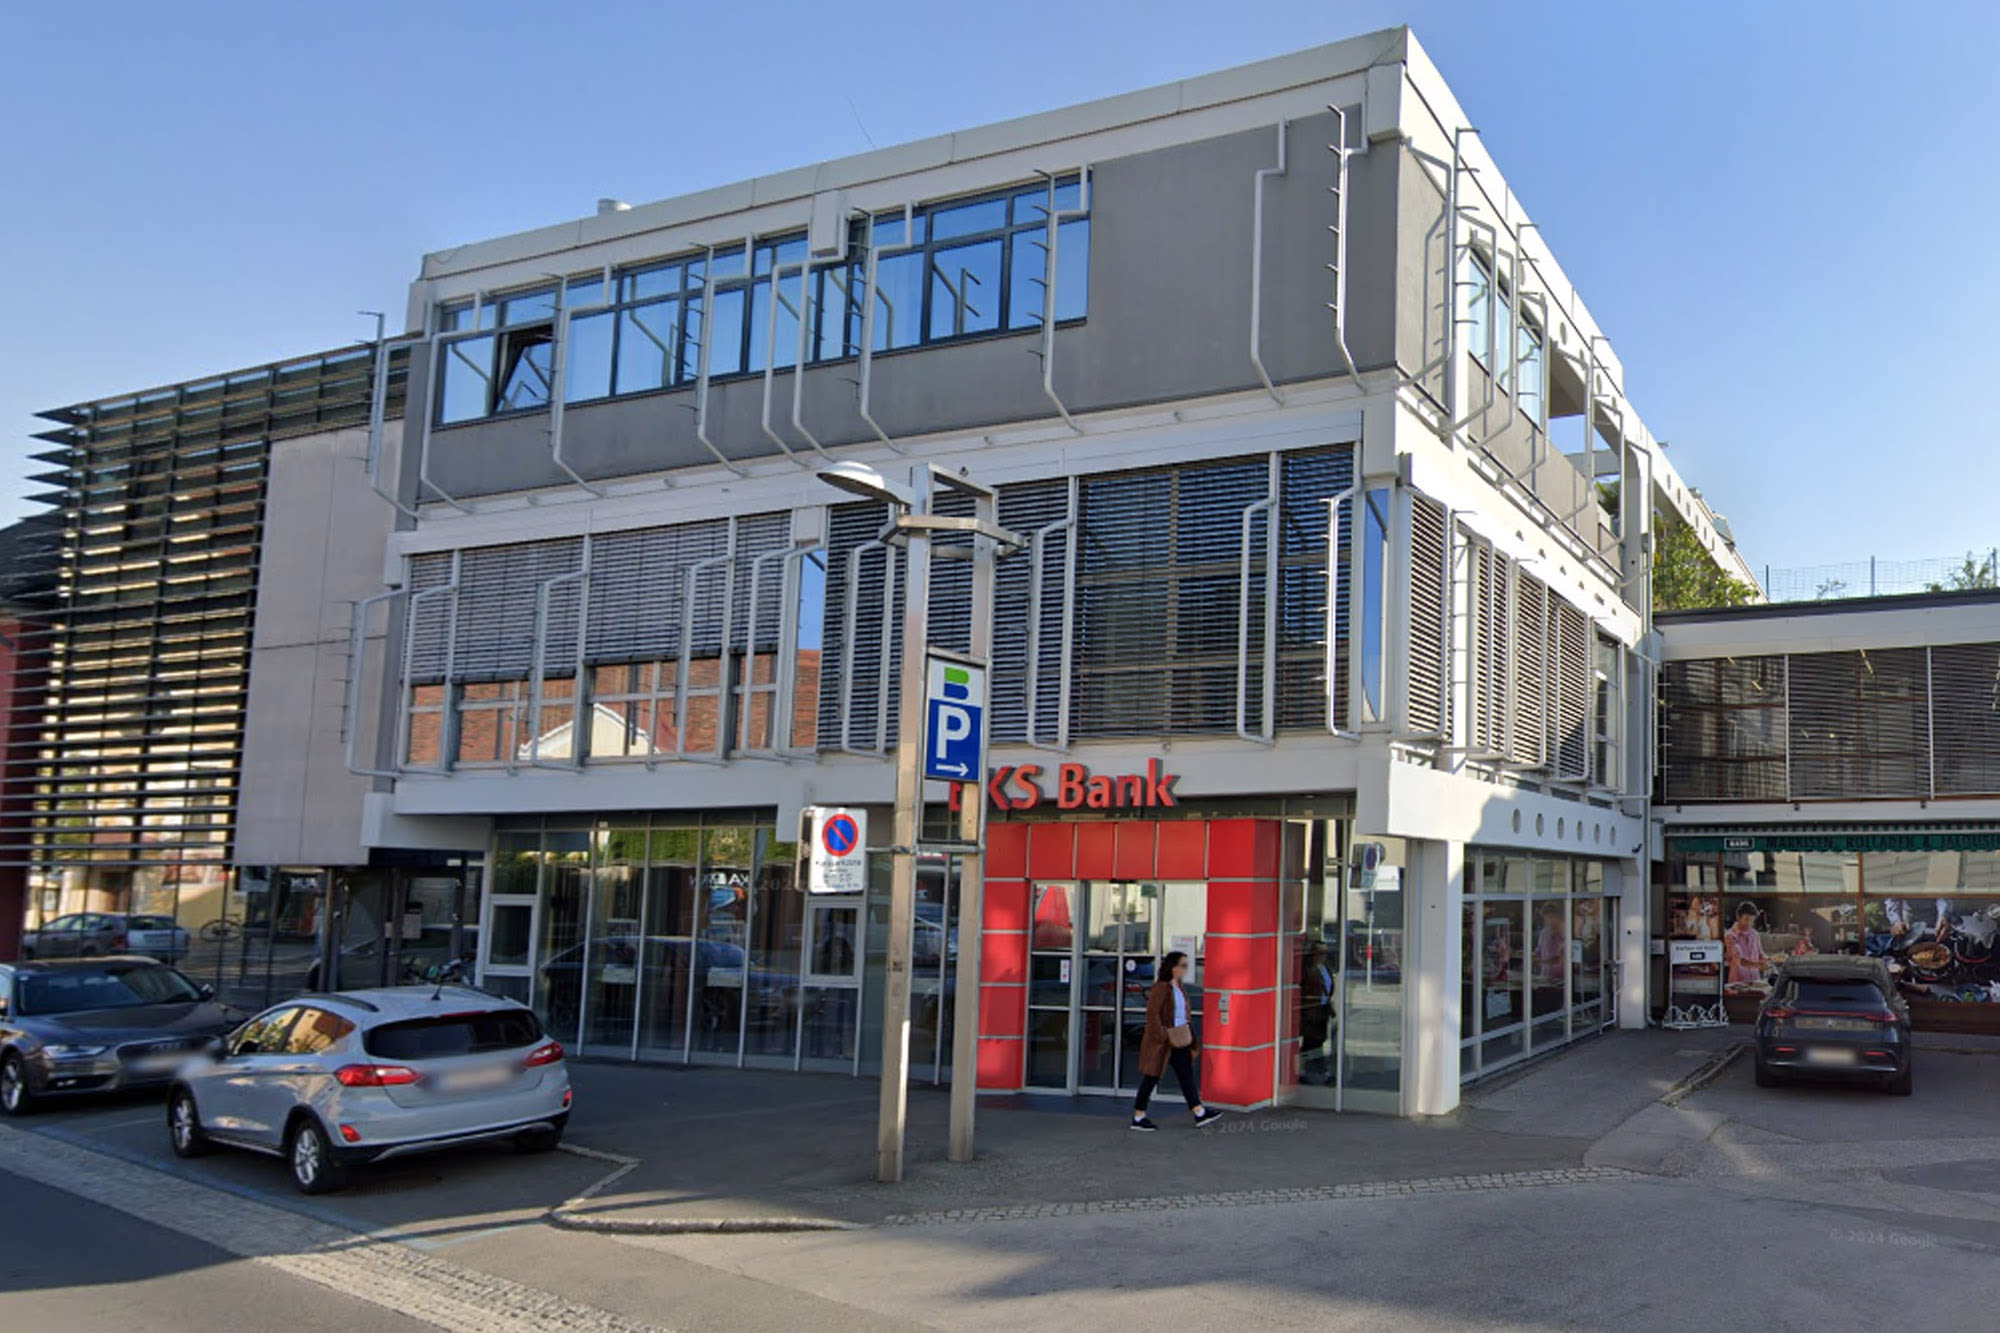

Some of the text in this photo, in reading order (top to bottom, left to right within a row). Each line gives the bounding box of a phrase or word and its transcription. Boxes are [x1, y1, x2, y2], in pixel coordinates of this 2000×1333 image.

[935, 703, 972, 760] P
[1057, 757, 1179, 810] Bank
[1941, 835, 2000, 850] JALOUSI
